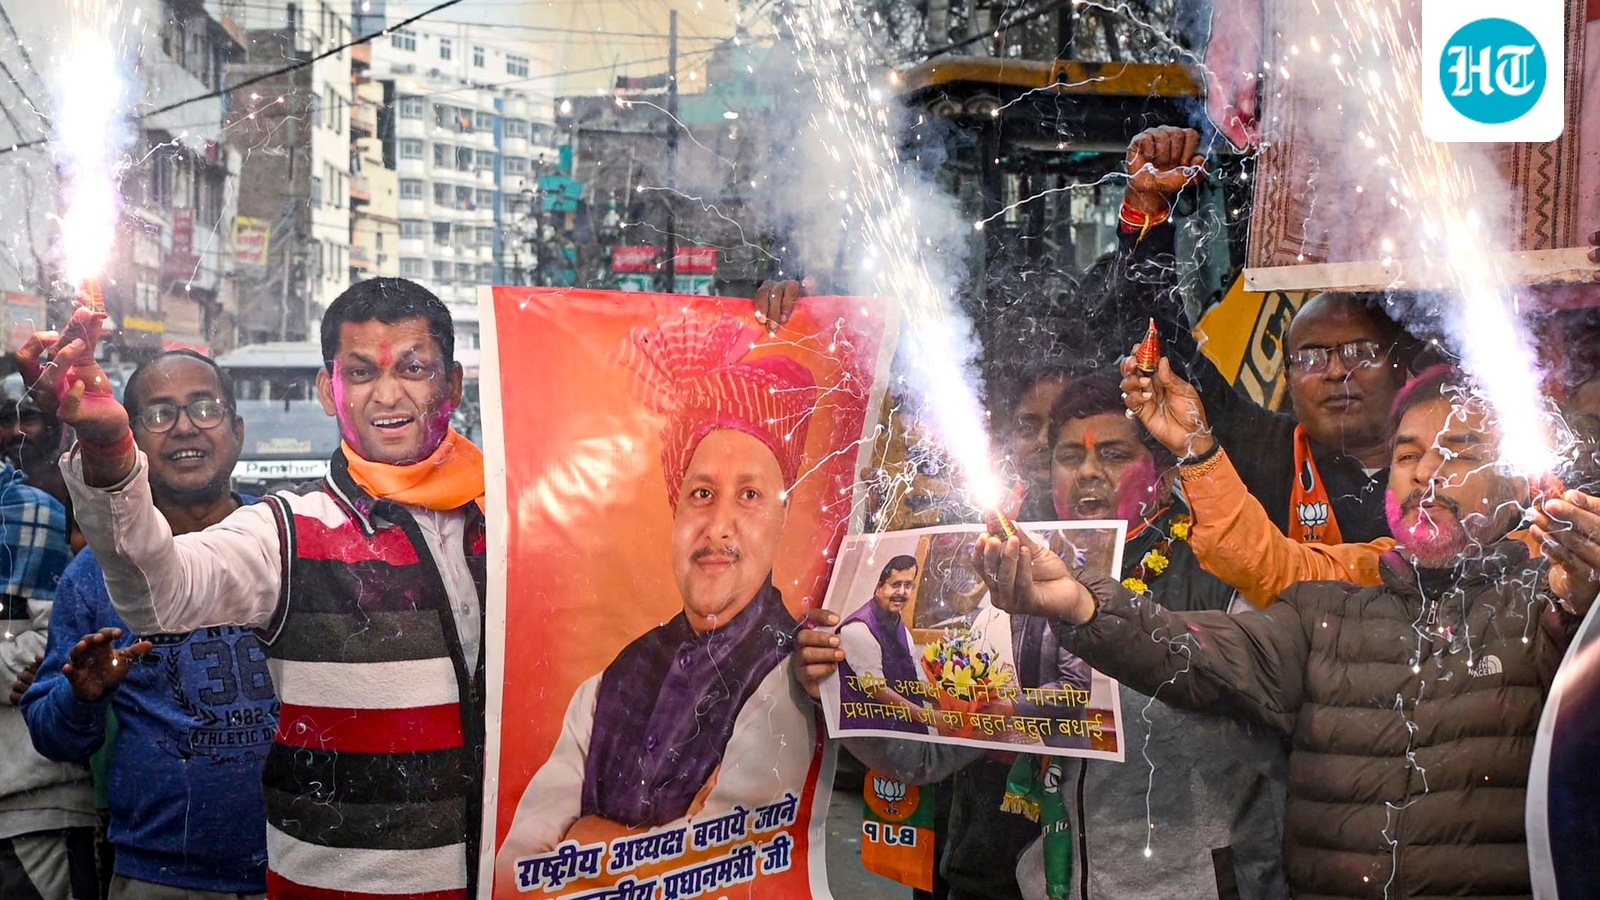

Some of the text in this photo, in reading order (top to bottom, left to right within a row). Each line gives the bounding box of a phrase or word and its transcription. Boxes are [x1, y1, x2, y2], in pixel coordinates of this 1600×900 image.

[246, 462, 318, 474] Panther
[845, 671, 888, 699] राष्ट्रीय
[894, 679, 941, 699] अध्यक्ष
[995, 686, 1019, 704] पर
[1023, 683, 1090, 708] माननीय
[190, 729, 259, 745] ATHLETIC
[842, 701, 1104, 742] प्रधानमंत्री जी का बहुत-बहुत बधाई
[517, 793, 798, 888] राष्ट्रीय अध्यक्ष बनाये जाने
[663, 845, 756, 900] प्रधानमंत्री
[761, 835, 791, 871] जी
